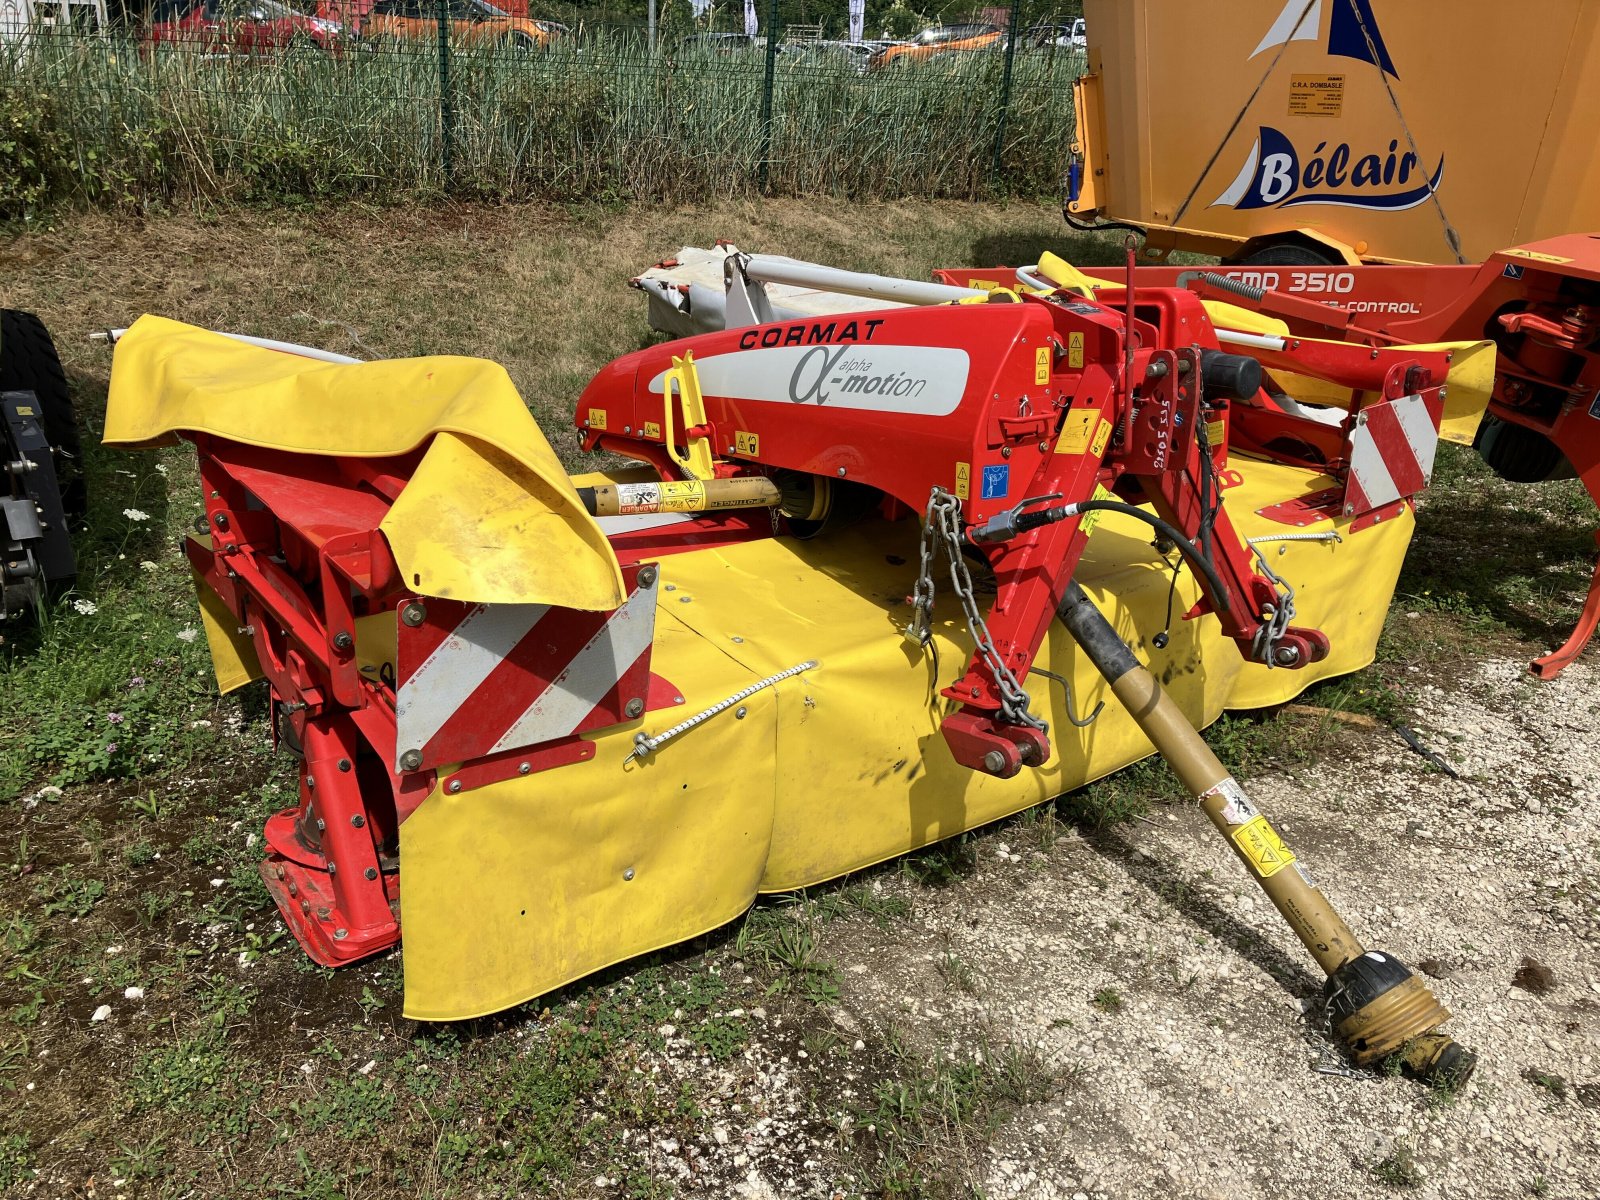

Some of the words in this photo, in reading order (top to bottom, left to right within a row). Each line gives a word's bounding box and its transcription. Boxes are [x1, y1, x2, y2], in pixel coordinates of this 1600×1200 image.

[1259, 139, 1416, 202] Bélair
[1288, 272, 1355, 293] 3510
[740, 319, 885, 350] CORMAT
[838, 358, 873, 374] alpha
